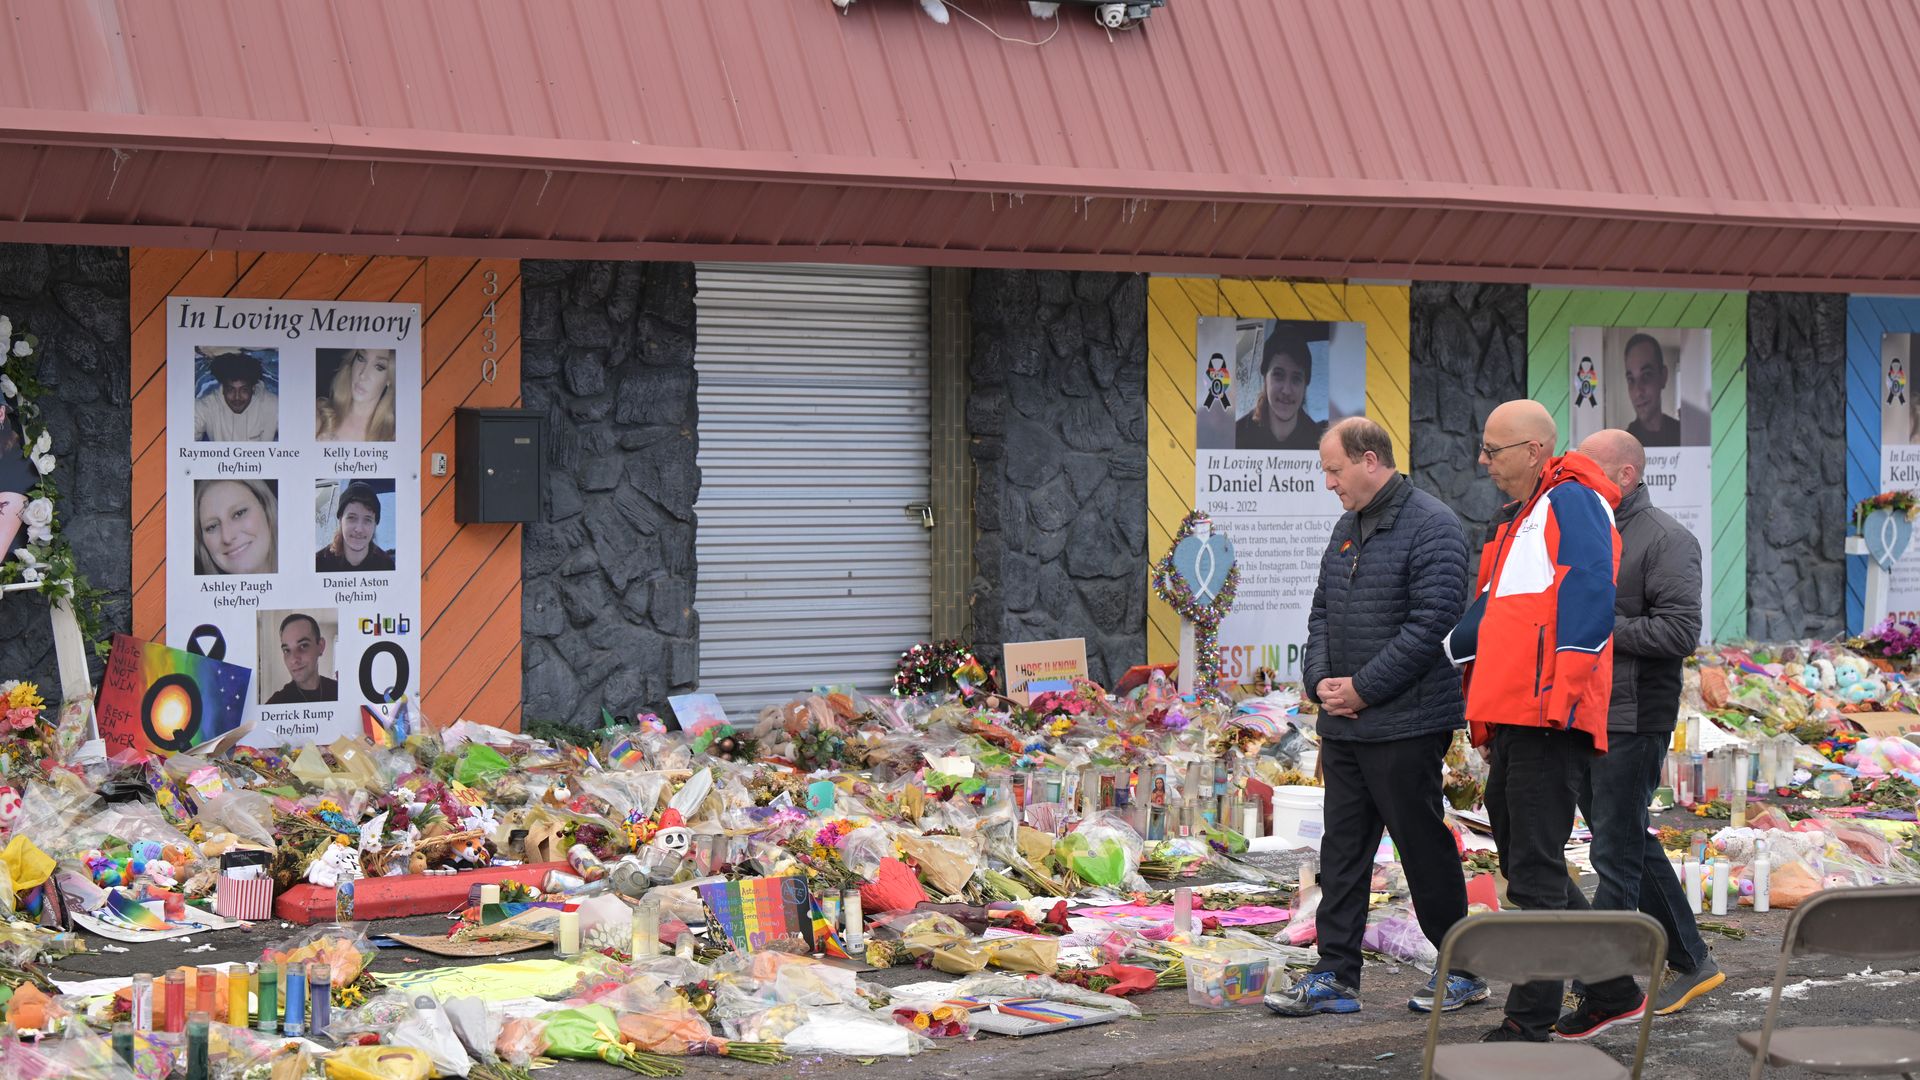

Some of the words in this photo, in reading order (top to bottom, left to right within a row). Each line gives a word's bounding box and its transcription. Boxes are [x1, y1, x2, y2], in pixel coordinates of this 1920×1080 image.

[178, 304, 205, 328] In
[213, 305, 303, 339] Loving
[308, 307, 411, 341] Memory
[482, 270, 498, 384] 3430
[179, 447, 230, 461] Raymond
[233, 447, 265, 458] Green
[268, 447, 300, 458] Vance
[323, 447, 350, 461] Kelly
[353, 448, 389, 461] Loving
[1669, 451, 1680, 469] of
[1890, 450, 1899, 462] In
[1901, 450, 1920, 462] Lovi
[217, 461, 262, 474] (he/him)
[334, 461, 378, 474] (she/her)
[1208, 456, 1220, 470] In
[1223, 456, 1263, 474] Loving
[1266, 456, 1312, 474] Memory
[1208, 474, 1262, 492] Daniel
[1268, 474, 1315, 492] Aston
[1646, 474, 1677, 491] ump
[1208, 501, 1228, 512] 1994
[1237, 501, 1257, 512] 2022
[1214, 521, 1232, 531] aniel
[1235, 523, 1249, 531] was
[1257, 521, 1293, 531] bartender
[1296, 522, 1303, 531] at
[1304, 520, 1322, 531] Club
[1230, 534, 1248, 544] oken
[1249, 535, 1268, 544] trans
[1290, 534, 1301, 544] he
[1235, 548, 1253, 558] raise
[1254, 548, 1292, 558] donations
[1293, 547, 1305, 557] for
[1246, 560, 1258, 571] his
[1259, 560, 1298, 573] Instagram.
[323, 577, 357, 588] Daniel
[359, 577, 389, 587] Aston
[1256, 574, 1268, 584] for
[1269, 573, 1281, 584] his
[1282, 574, 1311, 587] support
[200, 582, 237, 594] Ashley
[240, 580, 273, 593] Paugh
[1282, 586, 1298, 597] and
[213, 596, 260, 608] (she/her)
[334, 591, 377, 603] (he/him)
[1266, 600, 1278, 610] the
[361, 613, 410, 635] club
[1219, 645, 1255, 678] EST
[112, 665, 135, 678] NOT
[109, 676, 136, 693] WIN
[141, 673, 203, 753] Q
[261, 710, 300, 721] Derrick
[303, 709, 334, 721] Rump
[276, 723, 319, 736] (he/him)
